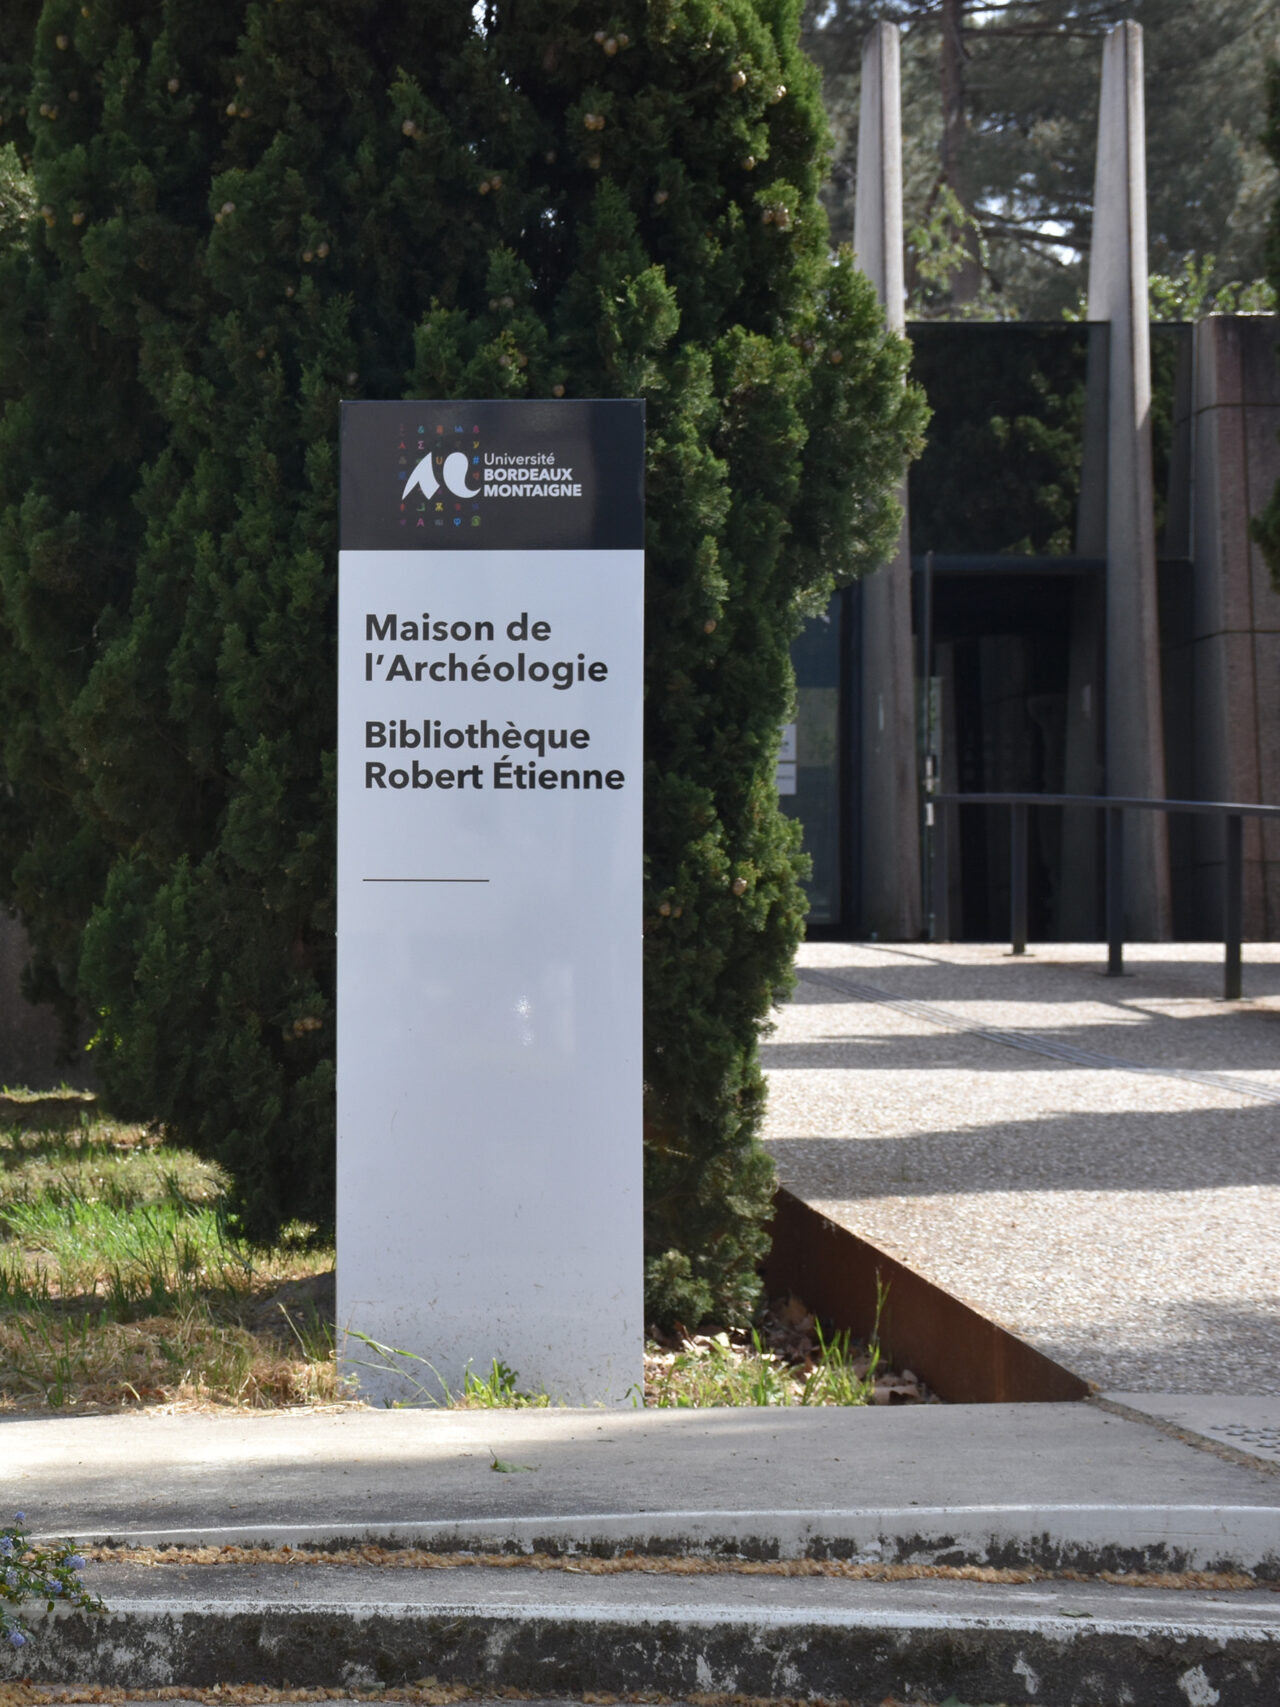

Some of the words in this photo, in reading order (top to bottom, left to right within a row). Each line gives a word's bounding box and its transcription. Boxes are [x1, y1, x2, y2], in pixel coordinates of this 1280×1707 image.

[484, 452, 556, 466] Université
[484, 468, 573, 482] BORDEAUX
[484, 484, 583, 498] MONTAIGNE
[365, 612, 495, 641] Maison
[506, 612, 552, 641] de
[365, 652, 609, 691] l'Archéologie
[365, 719, 591, 758] Bibliothèque
[365, 760, 483, 790] Robert
[493, 754, 626, 790] Étienne
